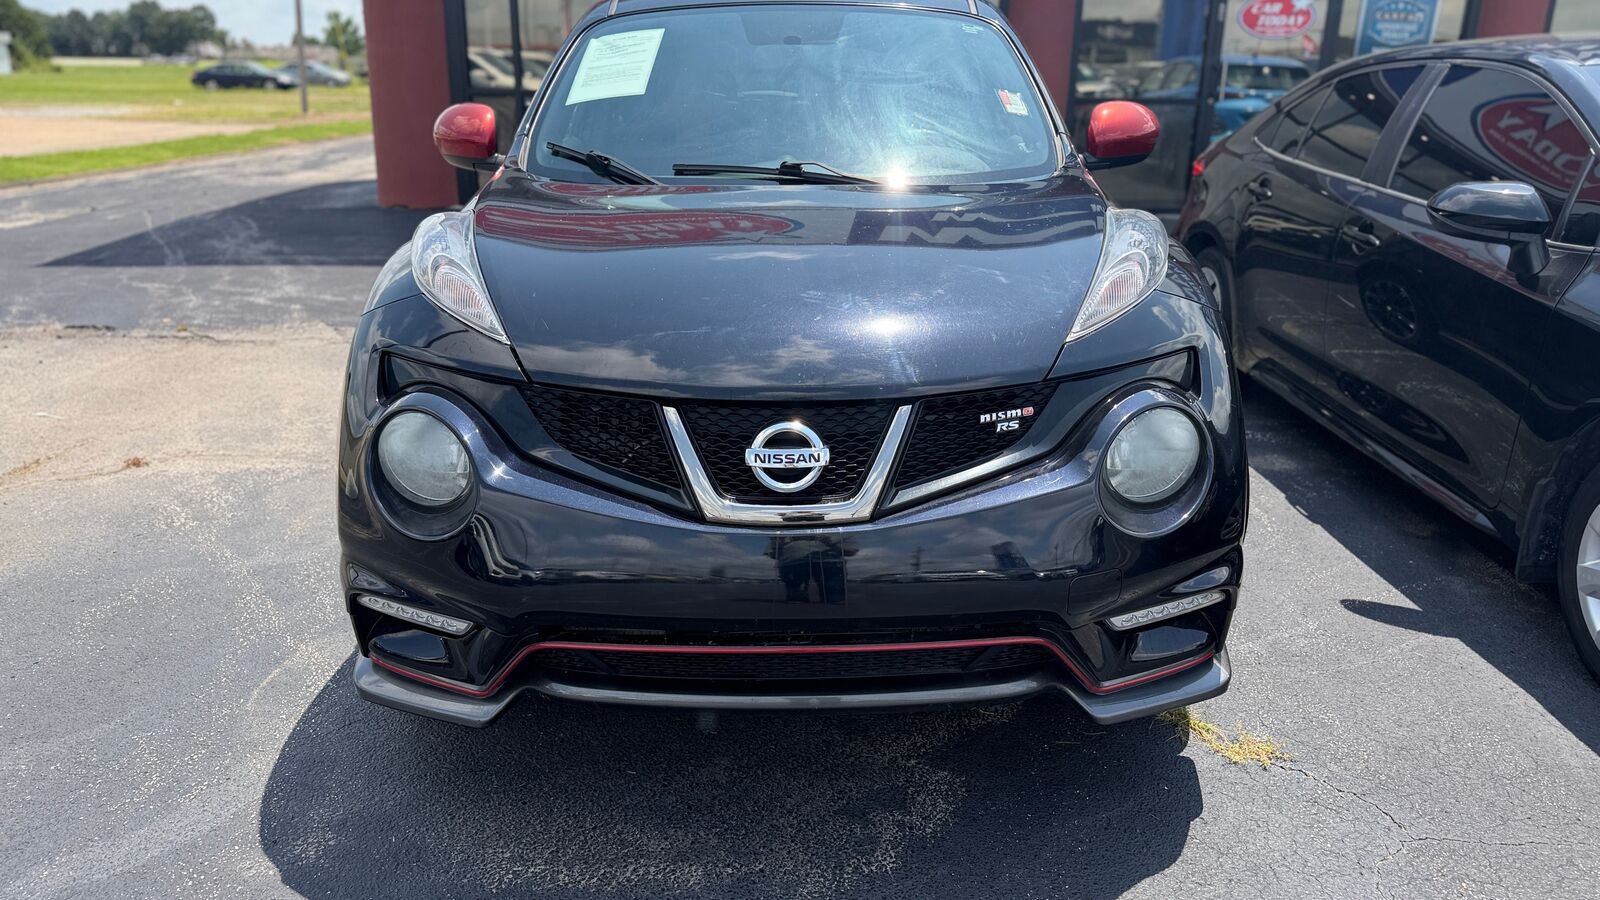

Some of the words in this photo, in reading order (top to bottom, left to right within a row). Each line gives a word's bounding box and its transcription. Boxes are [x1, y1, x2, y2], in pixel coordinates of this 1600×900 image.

[1250, 1, 1284, 15] CAR
[1257, 14, 1306, 26] TODAY
[996, 420, 1020, 432] RS
[754, 453, 821, 464] NISSAN
